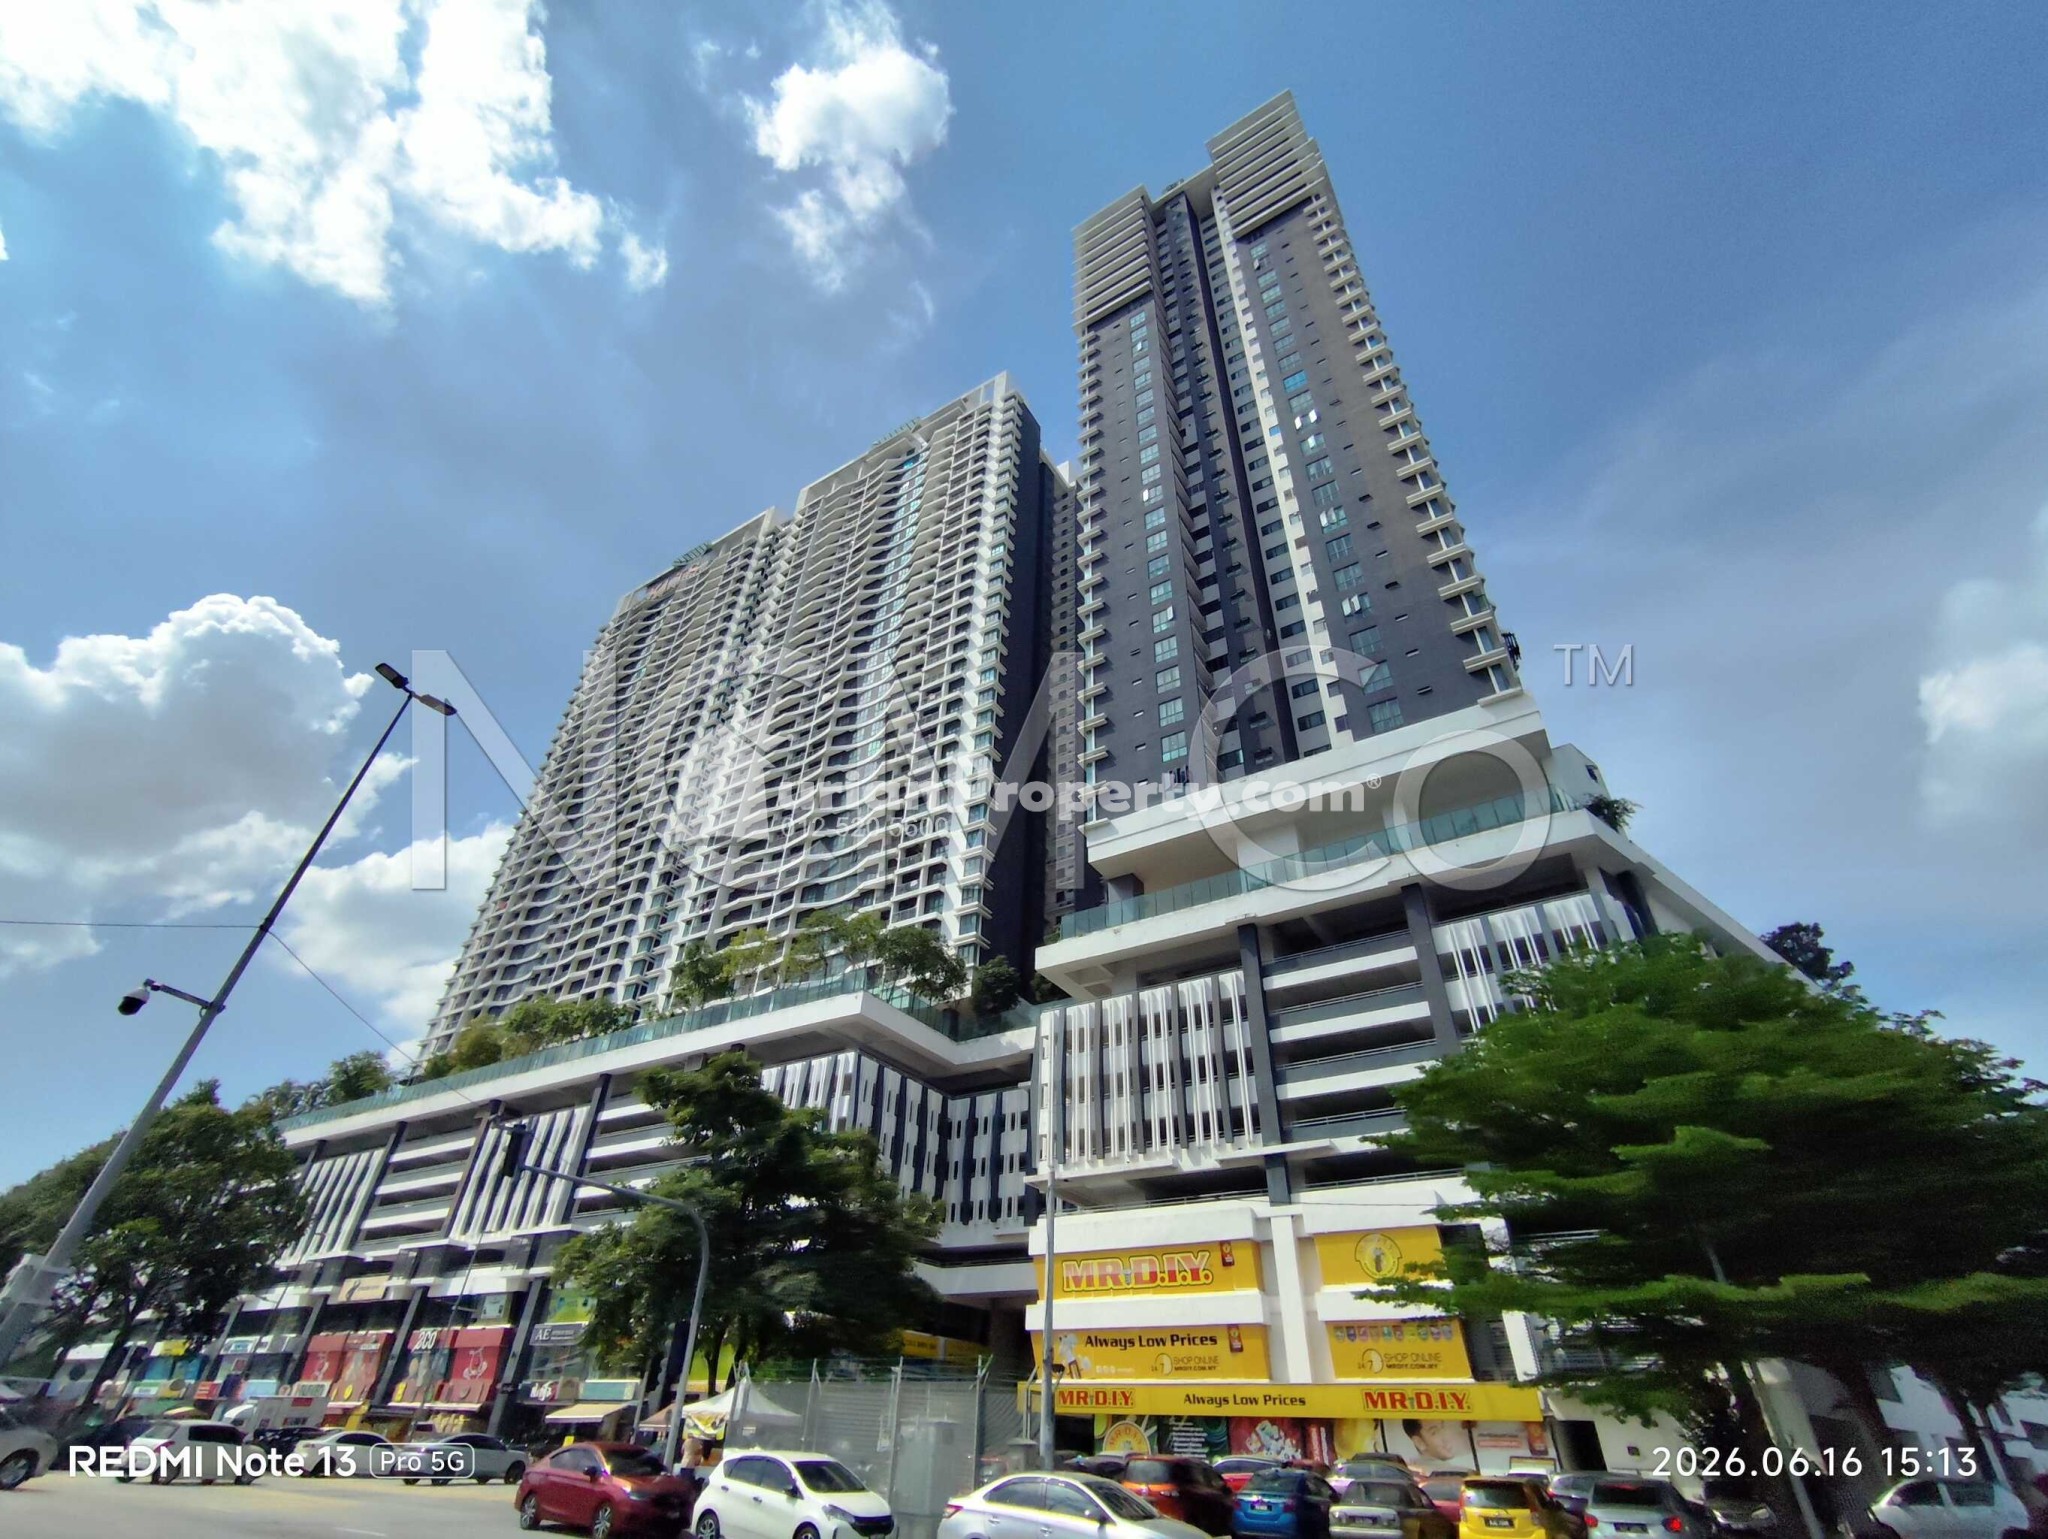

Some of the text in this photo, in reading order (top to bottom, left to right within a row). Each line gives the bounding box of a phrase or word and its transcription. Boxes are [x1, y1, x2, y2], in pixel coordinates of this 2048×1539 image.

[1085, 1333, 1217, 1350] Always Low Prices
[1184, 1393, 1230, 1408] Always
[1233, 1394, 1259, 1406] Low
[1263, 1394, 1306, 1406] Prices
